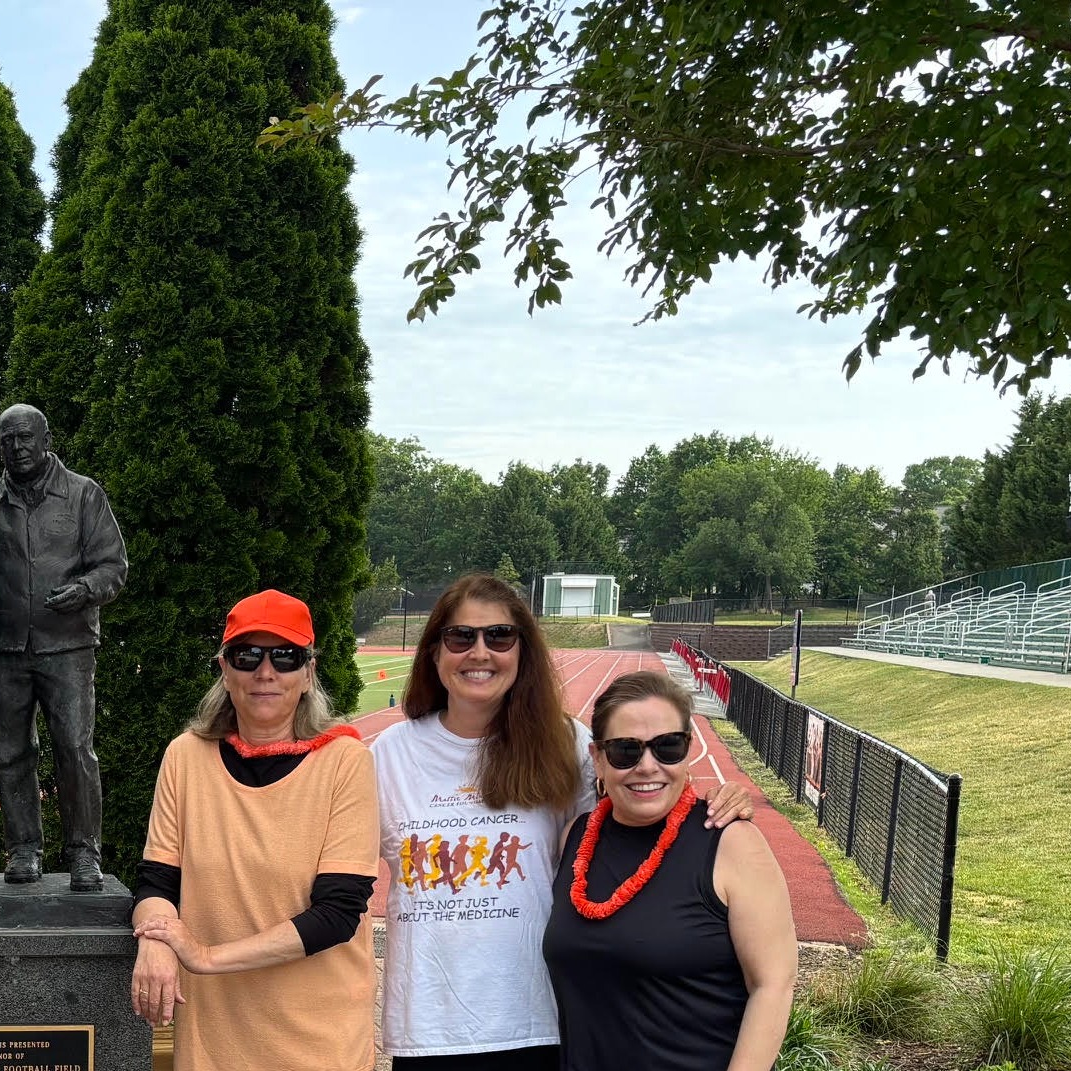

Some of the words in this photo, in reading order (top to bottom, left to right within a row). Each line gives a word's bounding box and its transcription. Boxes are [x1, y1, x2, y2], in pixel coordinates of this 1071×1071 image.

[398, 818, 467, 832] CHILDHOOD
[437, 899, 464, 911] NOT
[465, 897, 499, 909] JUST
[397, 912, 430, 922] ABOUT
[433, 911, 456, 921] THE
[457, 908, 521, 921] MEDICINE
[0, 1041, 7, 1049] IS
[9, 1041, 50, 1049] PRESENTED
[15, 1052, 25, 1060] OF
